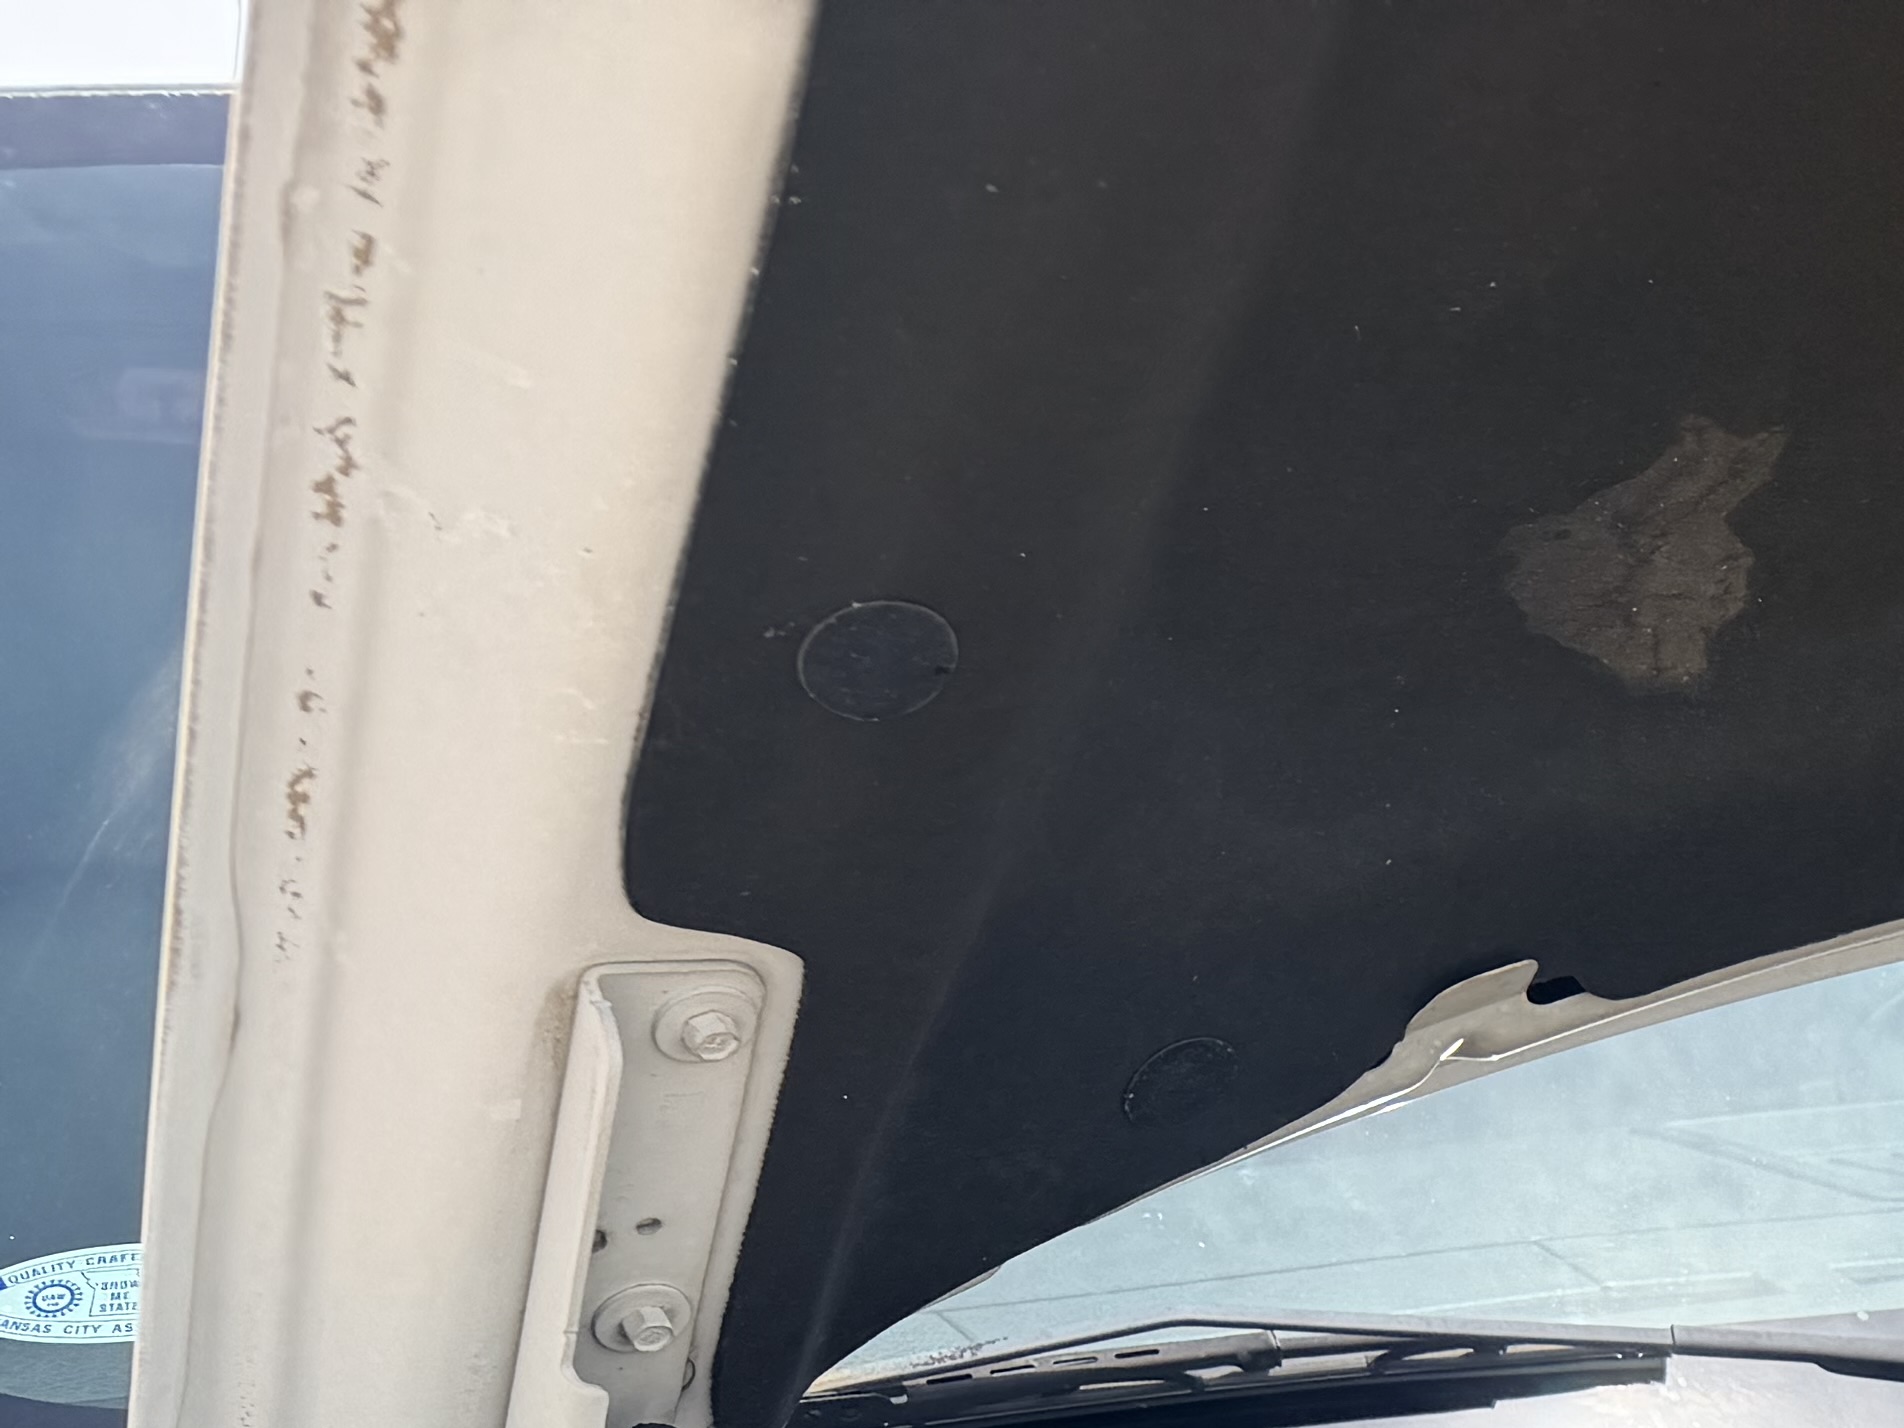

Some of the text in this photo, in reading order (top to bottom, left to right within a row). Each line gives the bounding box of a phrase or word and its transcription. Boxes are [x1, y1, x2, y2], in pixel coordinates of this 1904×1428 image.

[8, 1260, 75, 1284] QUALITY
[99, 1301, 138, 1313] STATE
[0, 1319, 52, 1334] ANSAS
[63, 1324, 102, 1335] CITY
